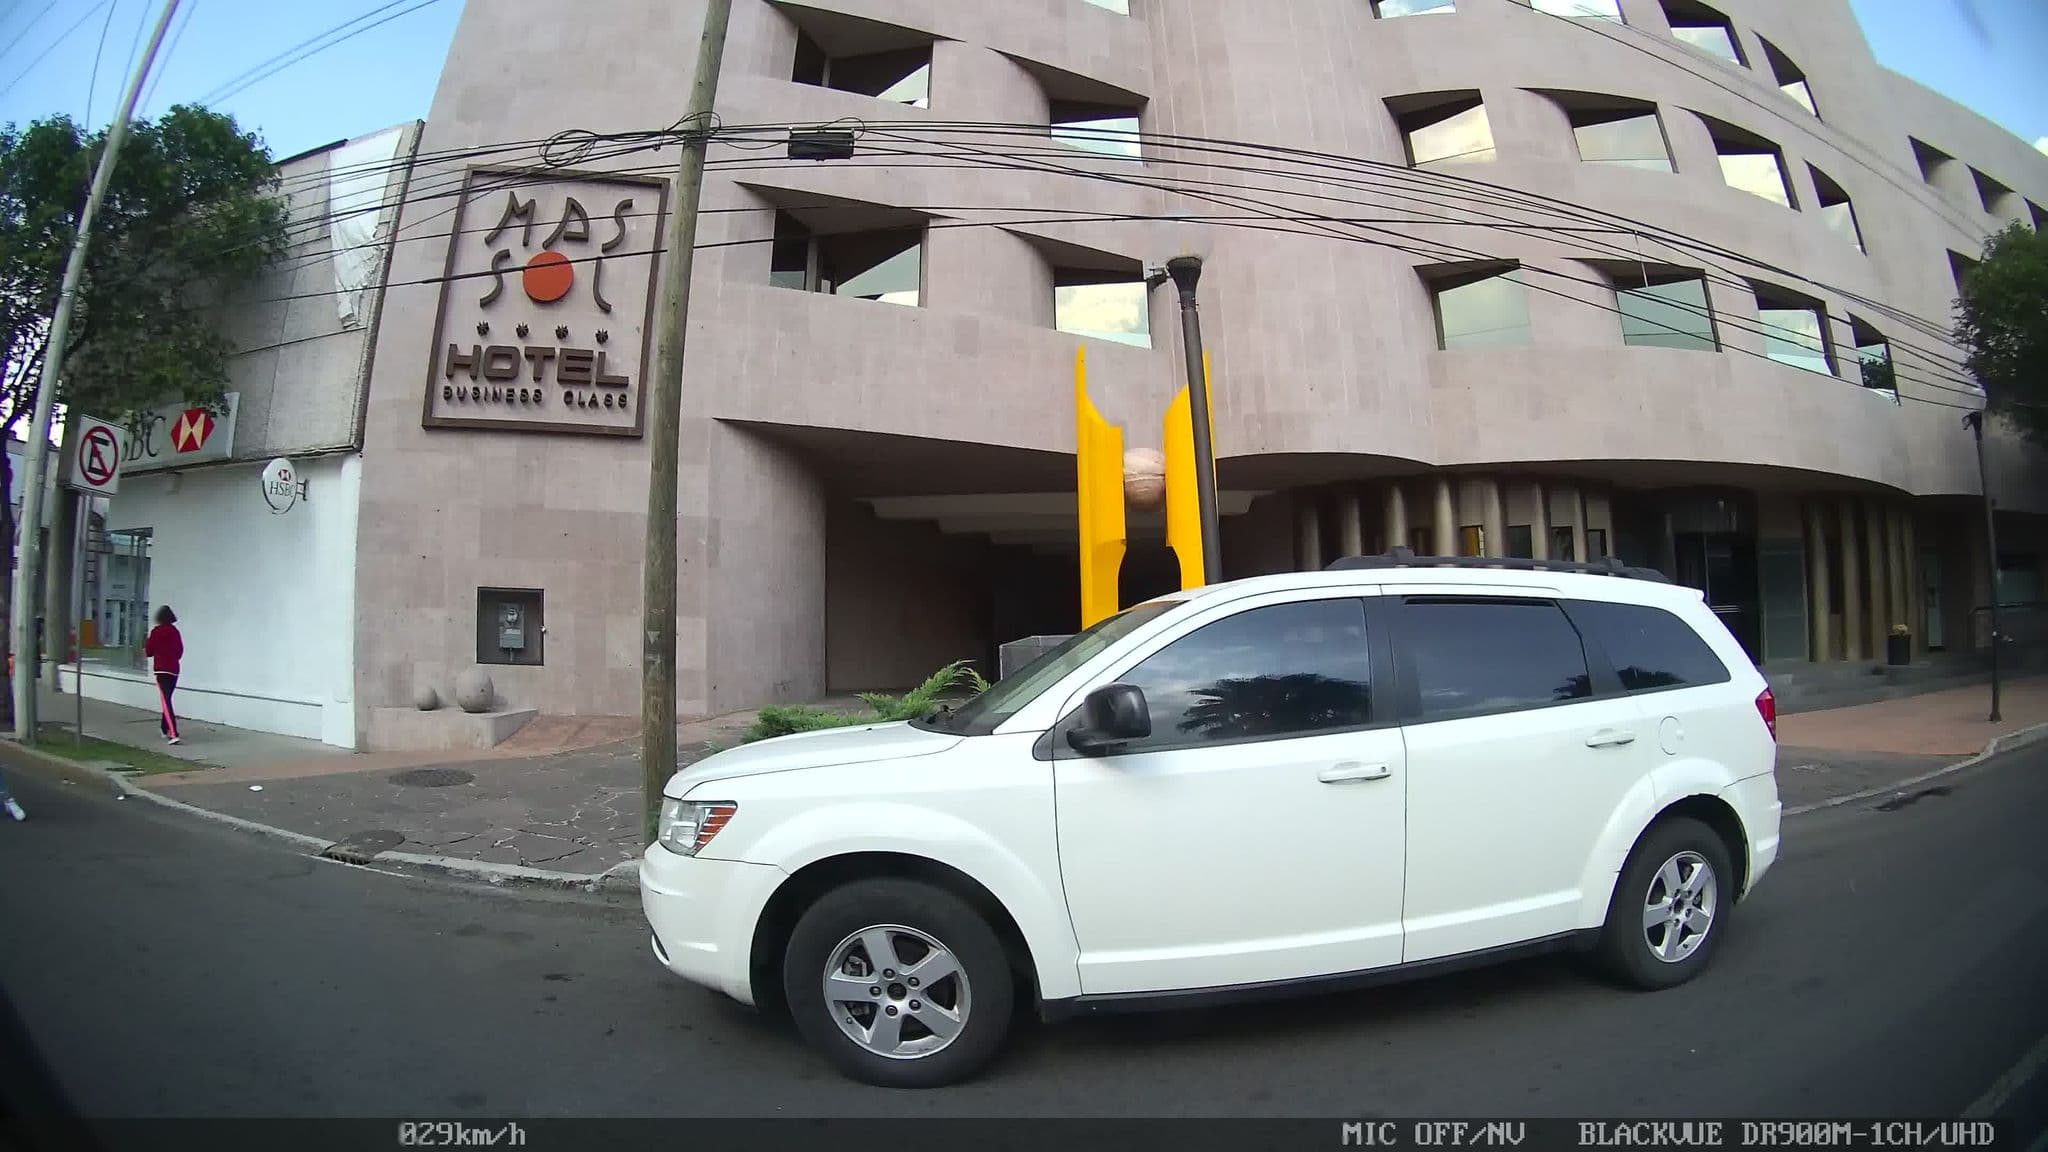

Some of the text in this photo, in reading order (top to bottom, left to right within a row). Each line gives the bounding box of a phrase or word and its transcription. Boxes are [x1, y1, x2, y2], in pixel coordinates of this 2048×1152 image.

[484, 191, 633, 253] MAS
[445, 343, 629, 387] HOTEL
[443, 385, 628, 410] BUSINESS CLASS
